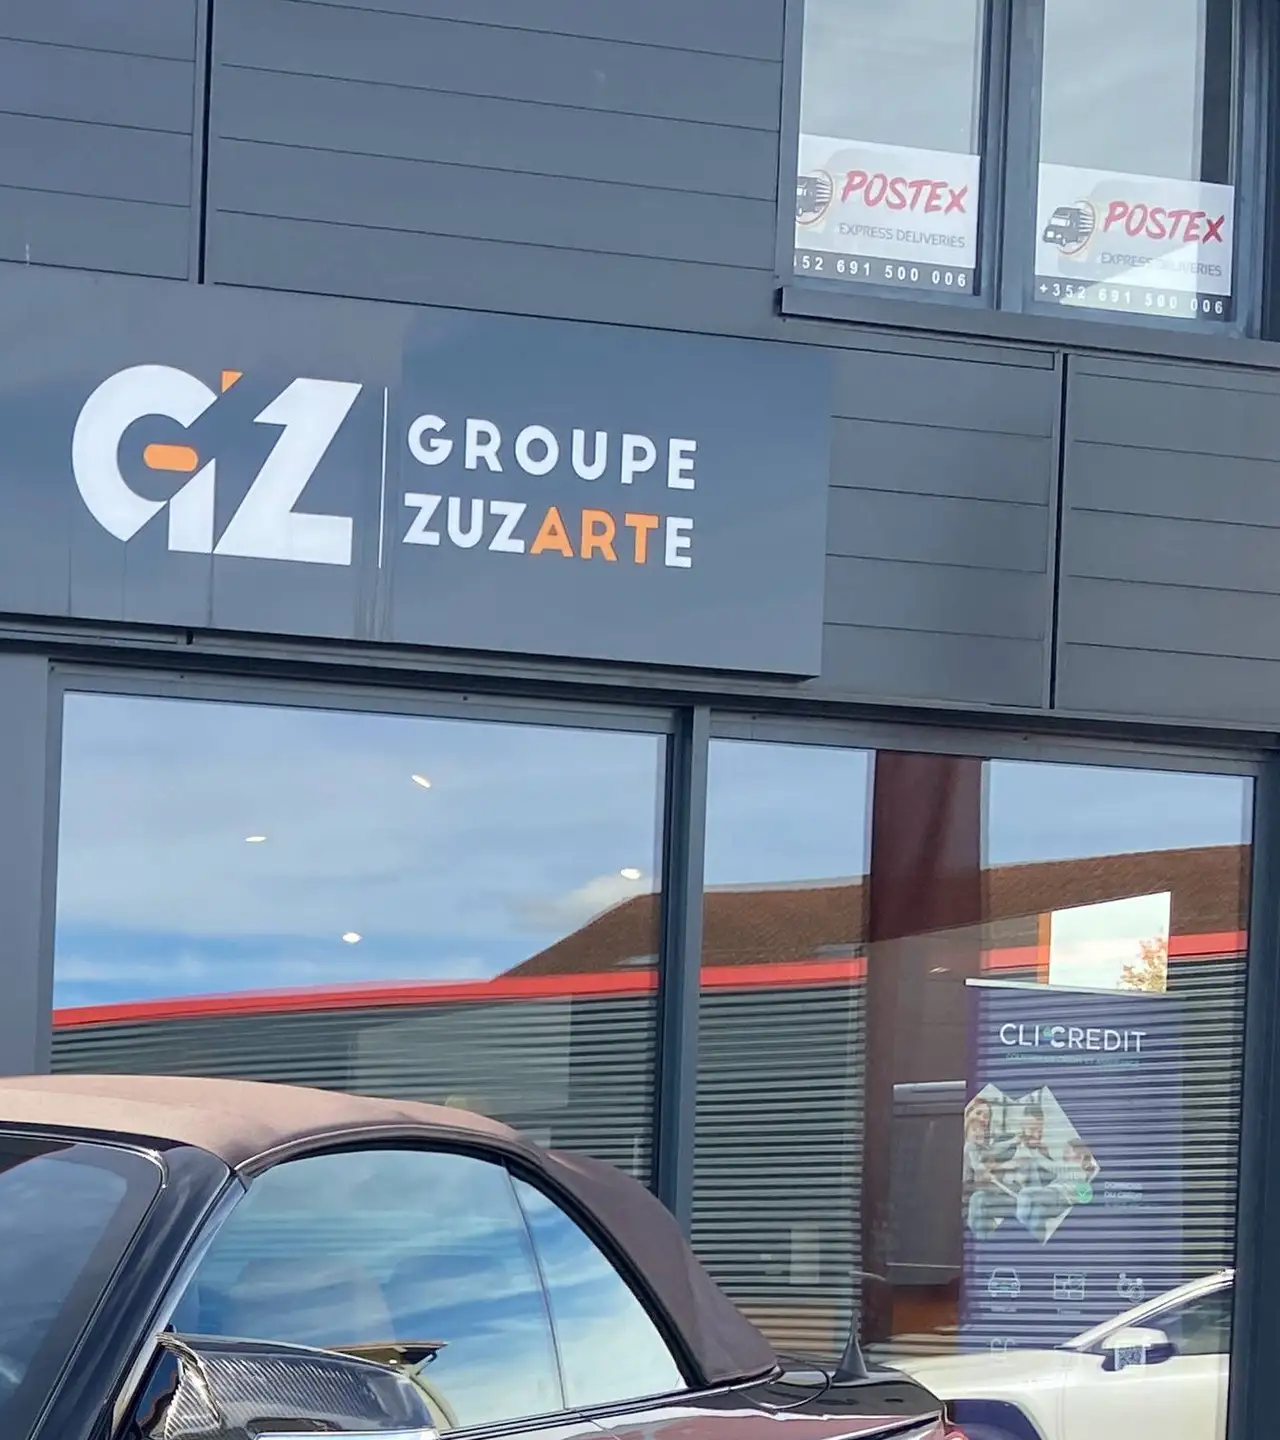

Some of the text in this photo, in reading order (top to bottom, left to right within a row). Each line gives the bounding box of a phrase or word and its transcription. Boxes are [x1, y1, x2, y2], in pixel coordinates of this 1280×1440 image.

[841, 170, 968, 214] POSTEX
[839, 223, 965, 248] EXPRESS DELIVERIES
[1103, 201, 1225, 244] POSTEX
[837, 260, 870, 276] 691
[885, 266, 918, 281] 500
[932, 271, 966, 287] 006
[1040, 283, 1223, 314] +352 691 500 006
[407, 414, 698, 491] GROUPE
[402, 493, 693, 569] ZUZARTE
